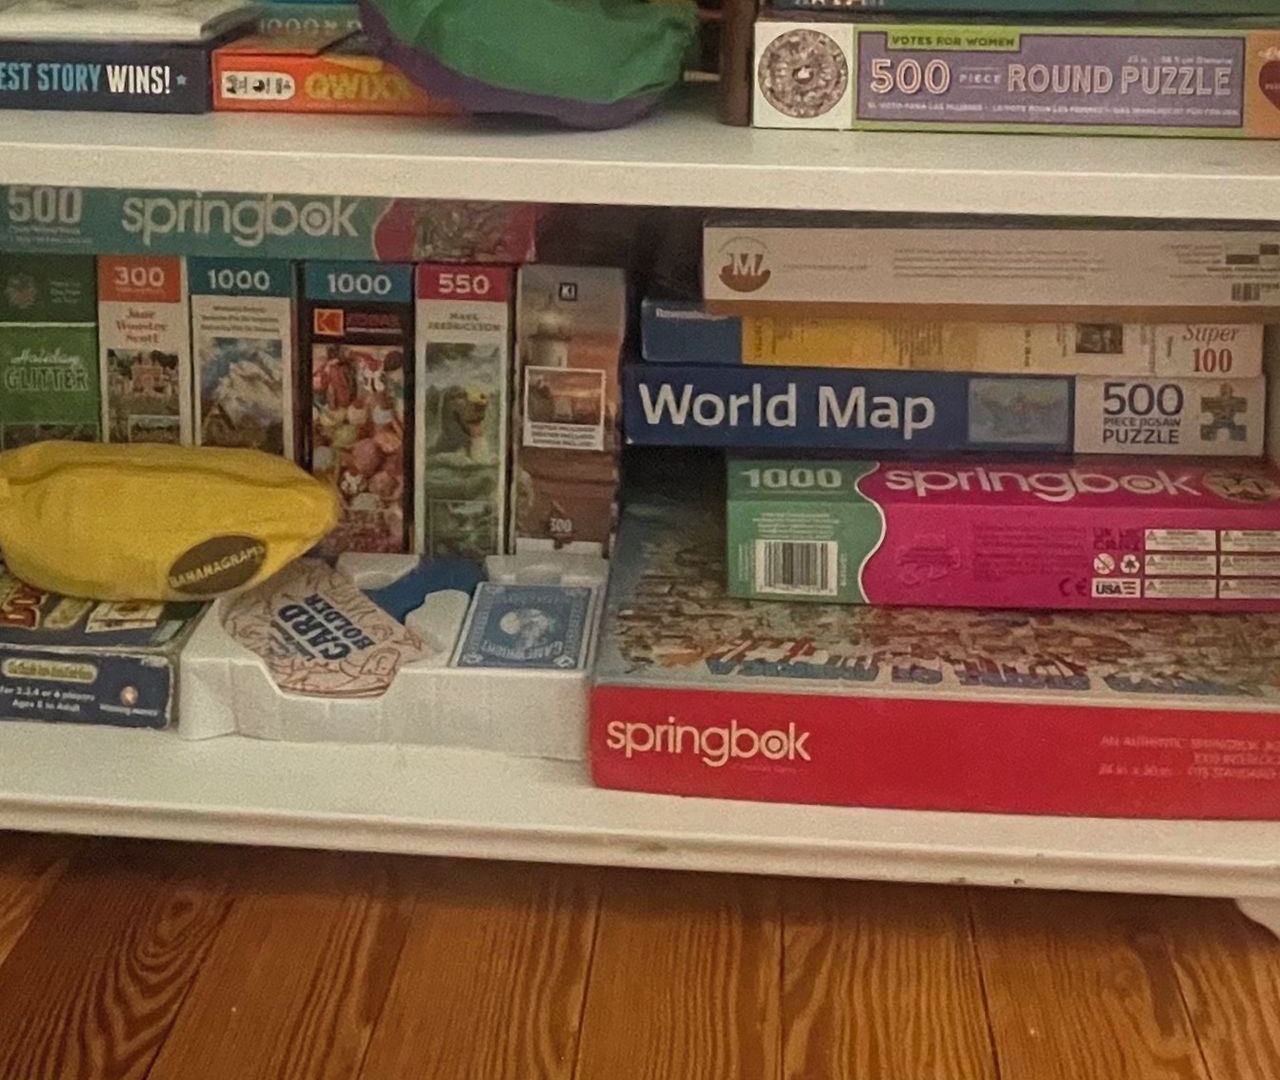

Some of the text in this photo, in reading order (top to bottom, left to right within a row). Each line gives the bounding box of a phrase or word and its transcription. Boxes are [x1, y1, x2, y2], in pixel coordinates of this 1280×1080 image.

[891, 35, 1015, 48] VOTES FOR WOMEN
[37, 63, 102, 94] STORY
[106, 64, 172, 95] WINS!
[869, 58, 1233, 96] 500 PIECE ROUND PUZZLE
[7, 182, 360, 247] 500 springbok
[115, 266, 165, 287] 300
[207, 269, 271, 292] 1000
[327, 273, 393, 296] 1000
[438, 273, 491, 296] 550
[1182, 324, 1241, 347] Super
[1192, 347, 1233, 373] 100
[638, 381, 936, 440] World Map
[1102, 381, 1185, 417] 500
[1102, 417, 1182, 430] PIECE JIGSAW
[1102, 429, 1181, 445] PUZZLE
[741, 468, 1203, 503] 1000 springbok
[169, 545, 266, 589] BANANAGRAMS
[1095, 583, 1123, 596] USA
[278, 604, 351, 661] CARD
[12, 698, 36, 710] Ages
[56, 701, 81, 712] Adult
[606, 716, 811, 768] springbok
